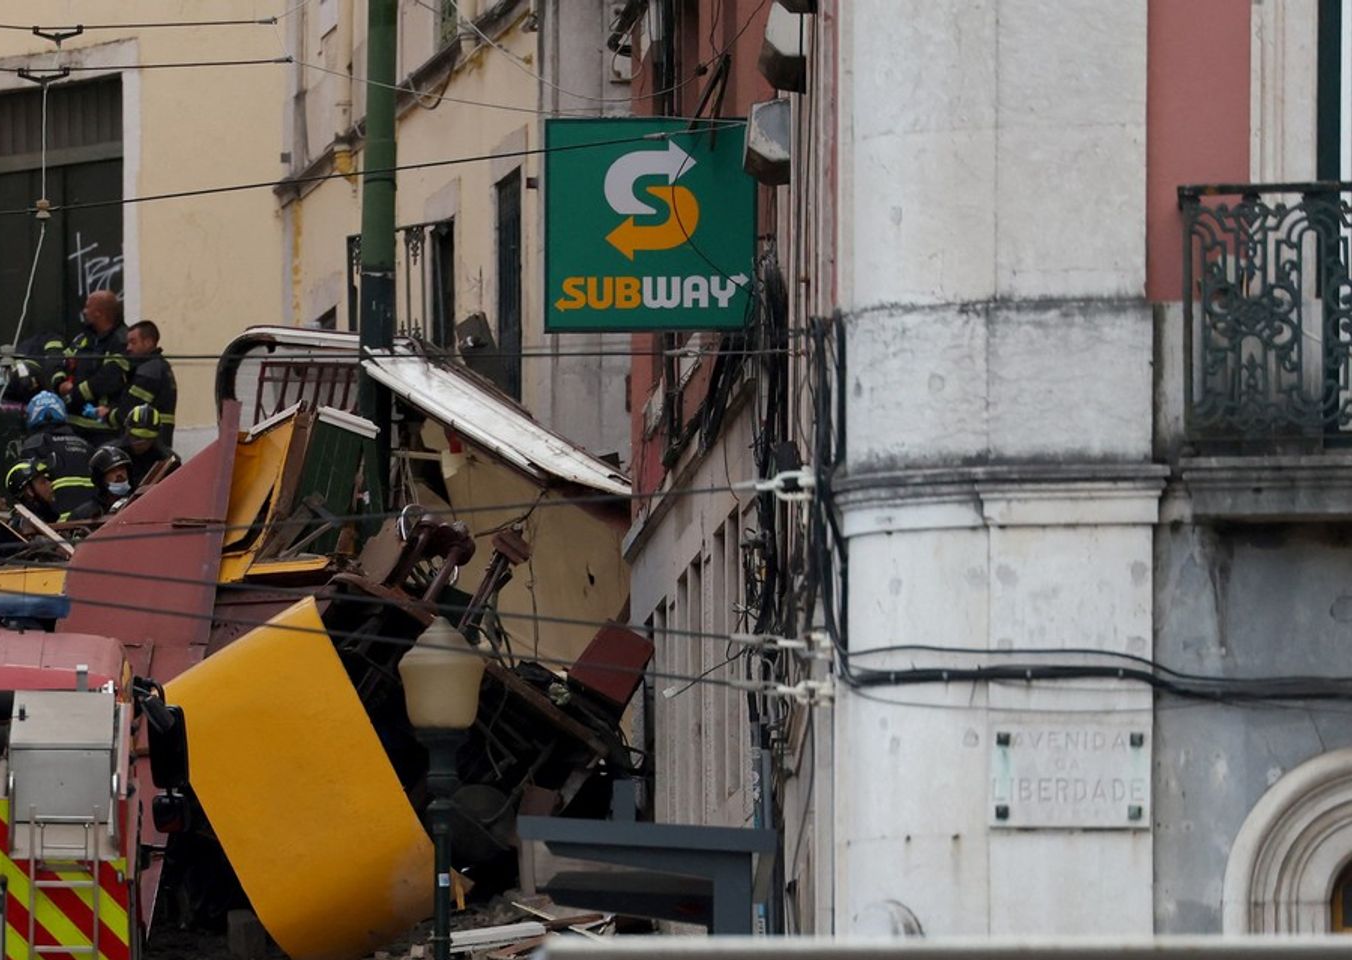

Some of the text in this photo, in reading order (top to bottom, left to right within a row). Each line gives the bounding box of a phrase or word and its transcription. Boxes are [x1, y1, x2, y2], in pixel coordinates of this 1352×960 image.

[554, 273, 750, 312] SUBWAY
[1012, 731, 1127, 752] AVENIDA
[992, 776, 1145, 804] LIBERDADE
